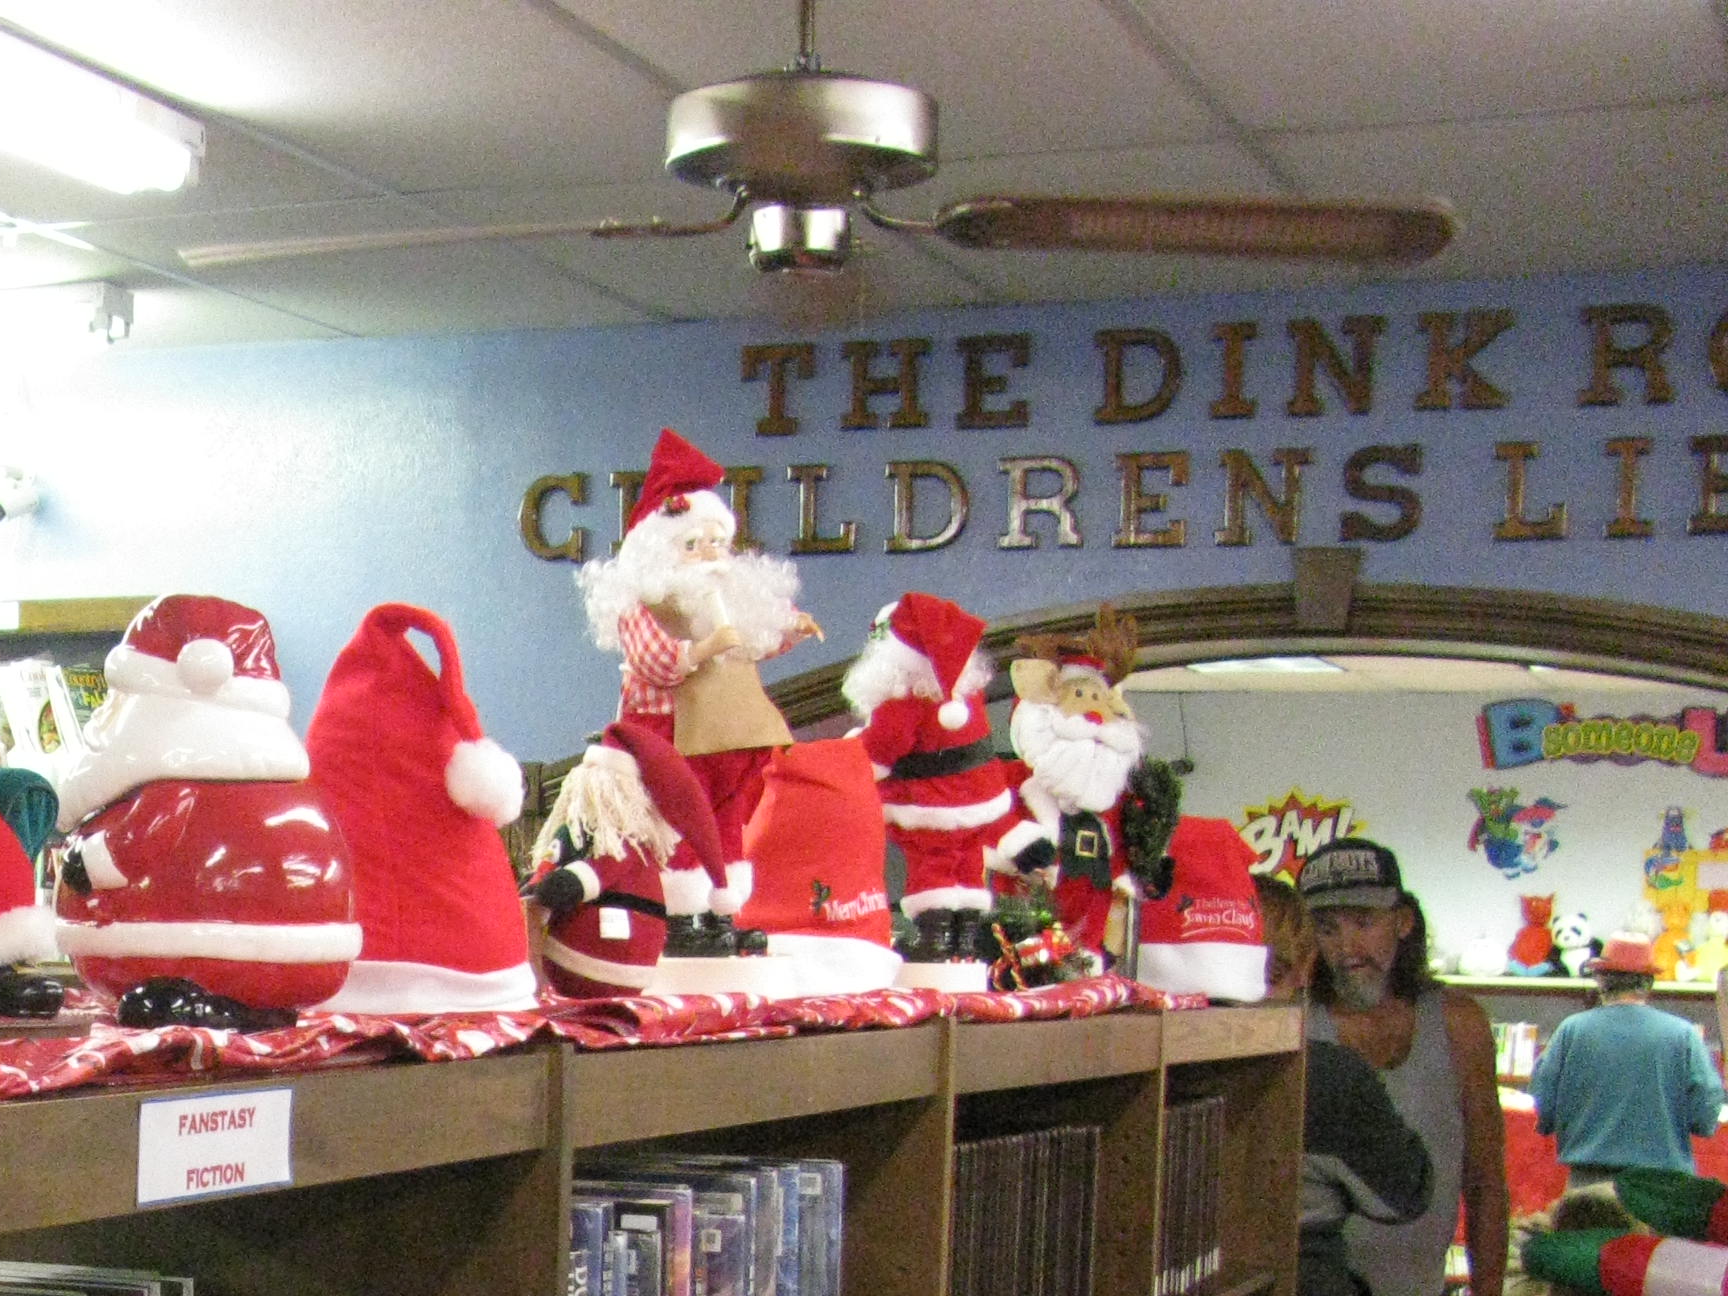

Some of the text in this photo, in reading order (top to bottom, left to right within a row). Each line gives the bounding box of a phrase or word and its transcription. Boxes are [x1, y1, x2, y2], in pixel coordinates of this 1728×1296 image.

[740, 332, 1032, 436] THE
[1093, 305, 1515, 425] DINK
[1542, 717, 1700, 765] someone
[1239, 807, 1354, 875] BAM!
[178, 1106, 257, 1136] FANSTASY
[186, 1162, 246, 1190] FICTION
